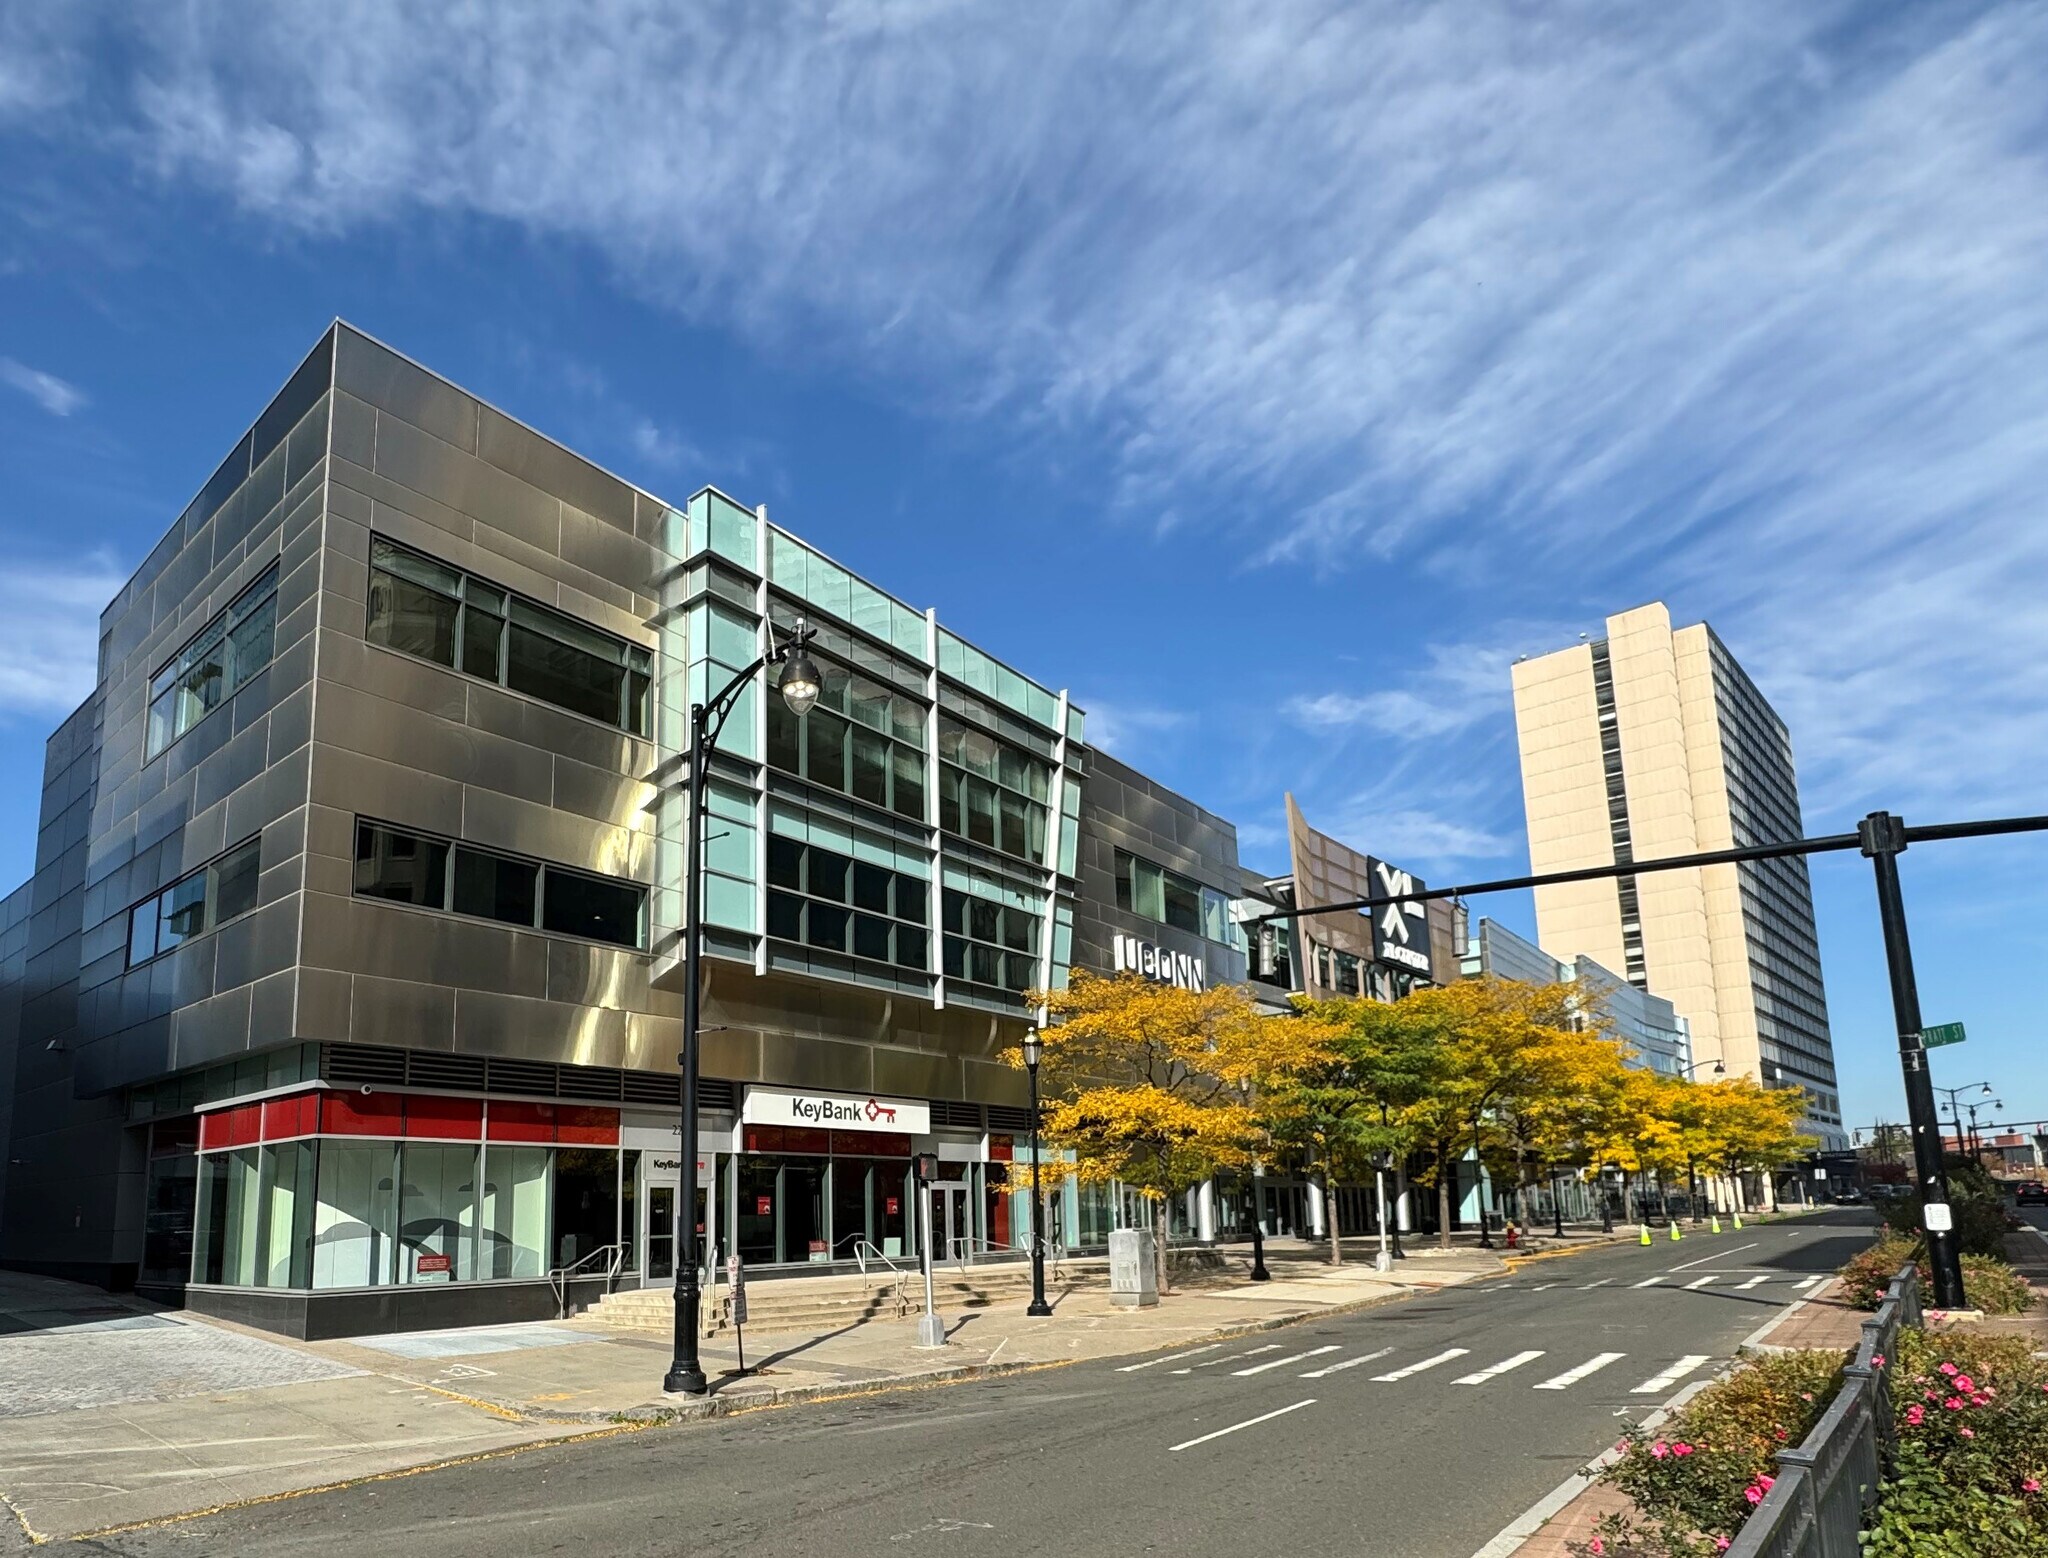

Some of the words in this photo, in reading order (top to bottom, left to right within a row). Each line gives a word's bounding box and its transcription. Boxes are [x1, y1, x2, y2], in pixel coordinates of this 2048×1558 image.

[1377, 862, 1425, 945] XL
[1113, 934, 1205, 994] UCONN
[1952, 1024, 1964, 1040] ST
[792, 1097, 862, 1122] KeyBank
[672, 1125, 682, 1135] 22
